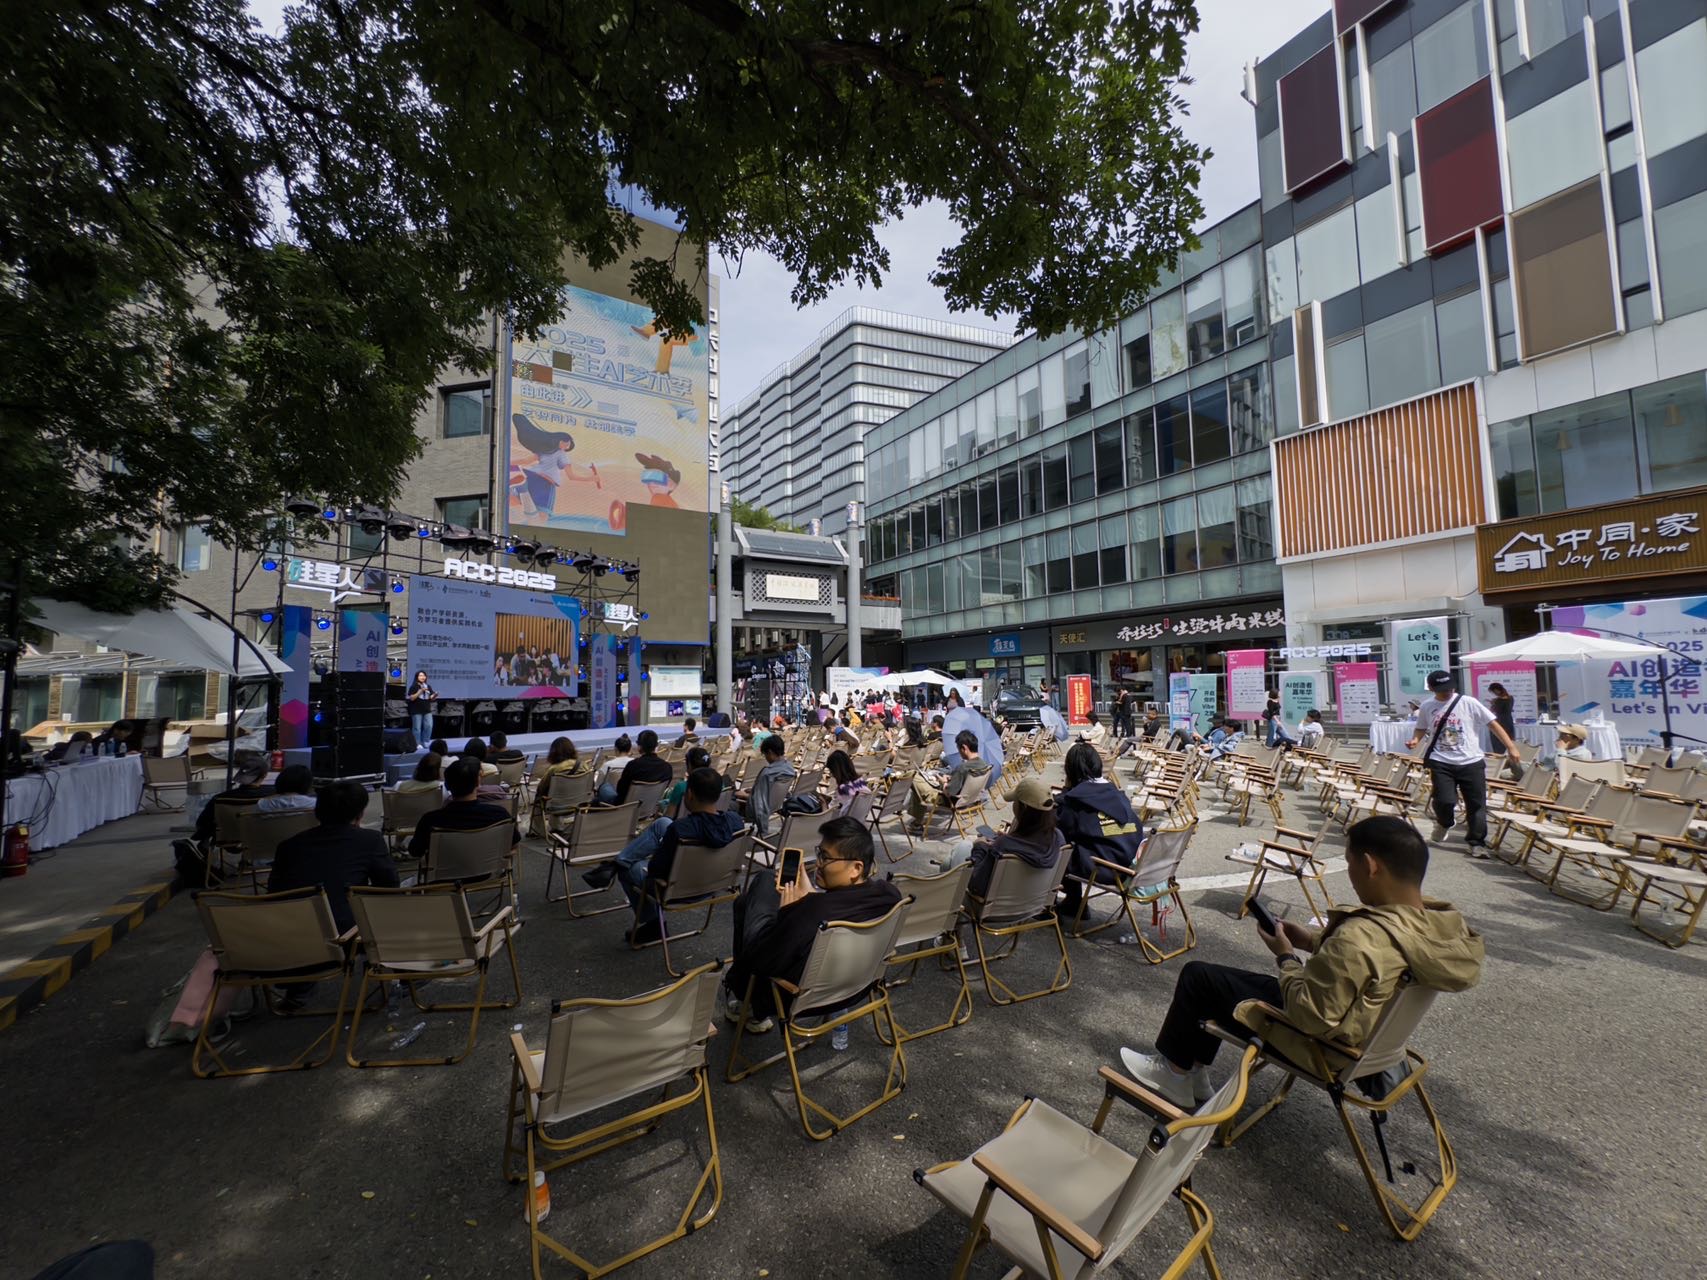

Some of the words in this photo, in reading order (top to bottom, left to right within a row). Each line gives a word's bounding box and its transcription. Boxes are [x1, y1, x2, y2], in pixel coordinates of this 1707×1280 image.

[543, 327, 606, 355] 025
[1557, 551, 1593, 569] Joy
[1599, 547, 1620, 561] To
[1627, 541, 1691, 558] Home
[287, 559, 362, 590] 硅星人
[1059, 632, 1086, 644] 天使汇
[1665, 640, 1704, 652] 025
[1428, 642, 1440, 651] in
[1412, 653, 1440, 662] Vibe
[1608, 658, 1707, 678] AI创造
[1609, 678, 1700, 699] 嘉年华
[1612, 702, 1657, 714] Let's
